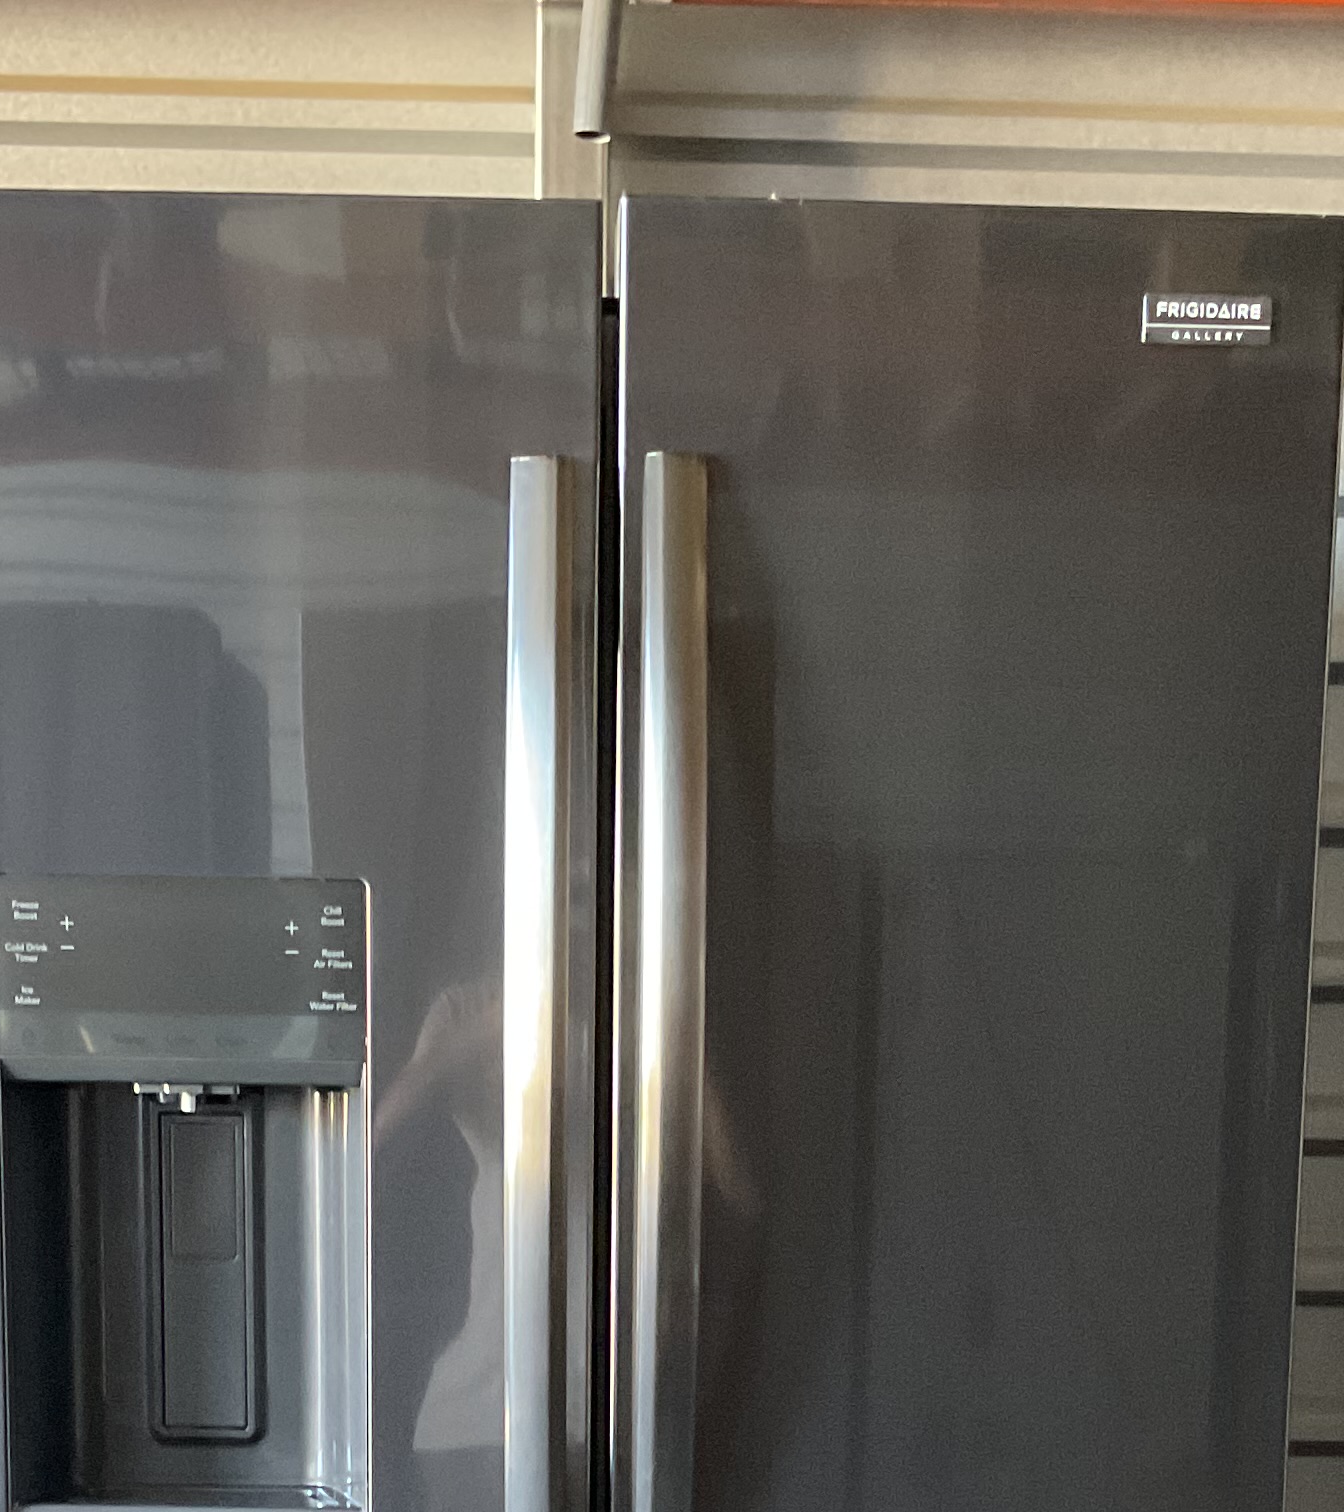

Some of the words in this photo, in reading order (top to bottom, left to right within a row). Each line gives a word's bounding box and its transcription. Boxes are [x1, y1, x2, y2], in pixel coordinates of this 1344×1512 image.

[1156, 301, 1261, 320] FRIGIDAIRE
[1171, 330, 1244, 341] GALLERY
[4, 942, 24, 952] Cold
[26, 942, 47, 952] Drink
